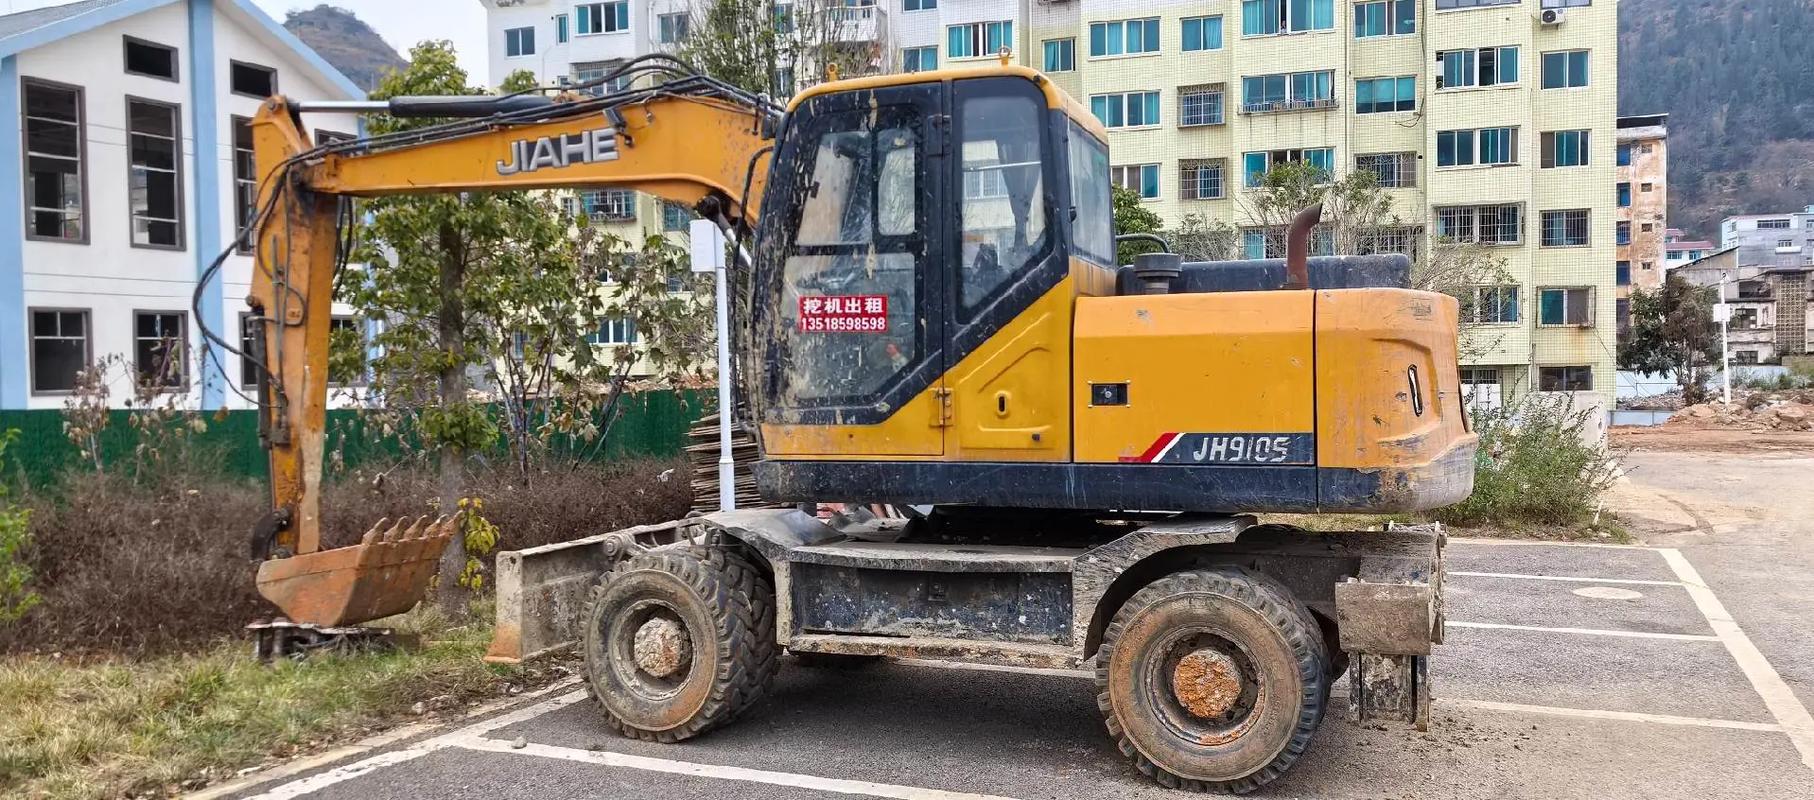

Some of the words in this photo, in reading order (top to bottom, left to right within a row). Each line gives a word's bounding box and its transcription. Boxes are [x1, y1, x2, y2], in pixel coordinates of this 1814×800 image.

[496, 127, 618, 174] JIAHE
[803, 297, 883, 314] 挖机出租
[802, 317, 885, 330] 13518598598
